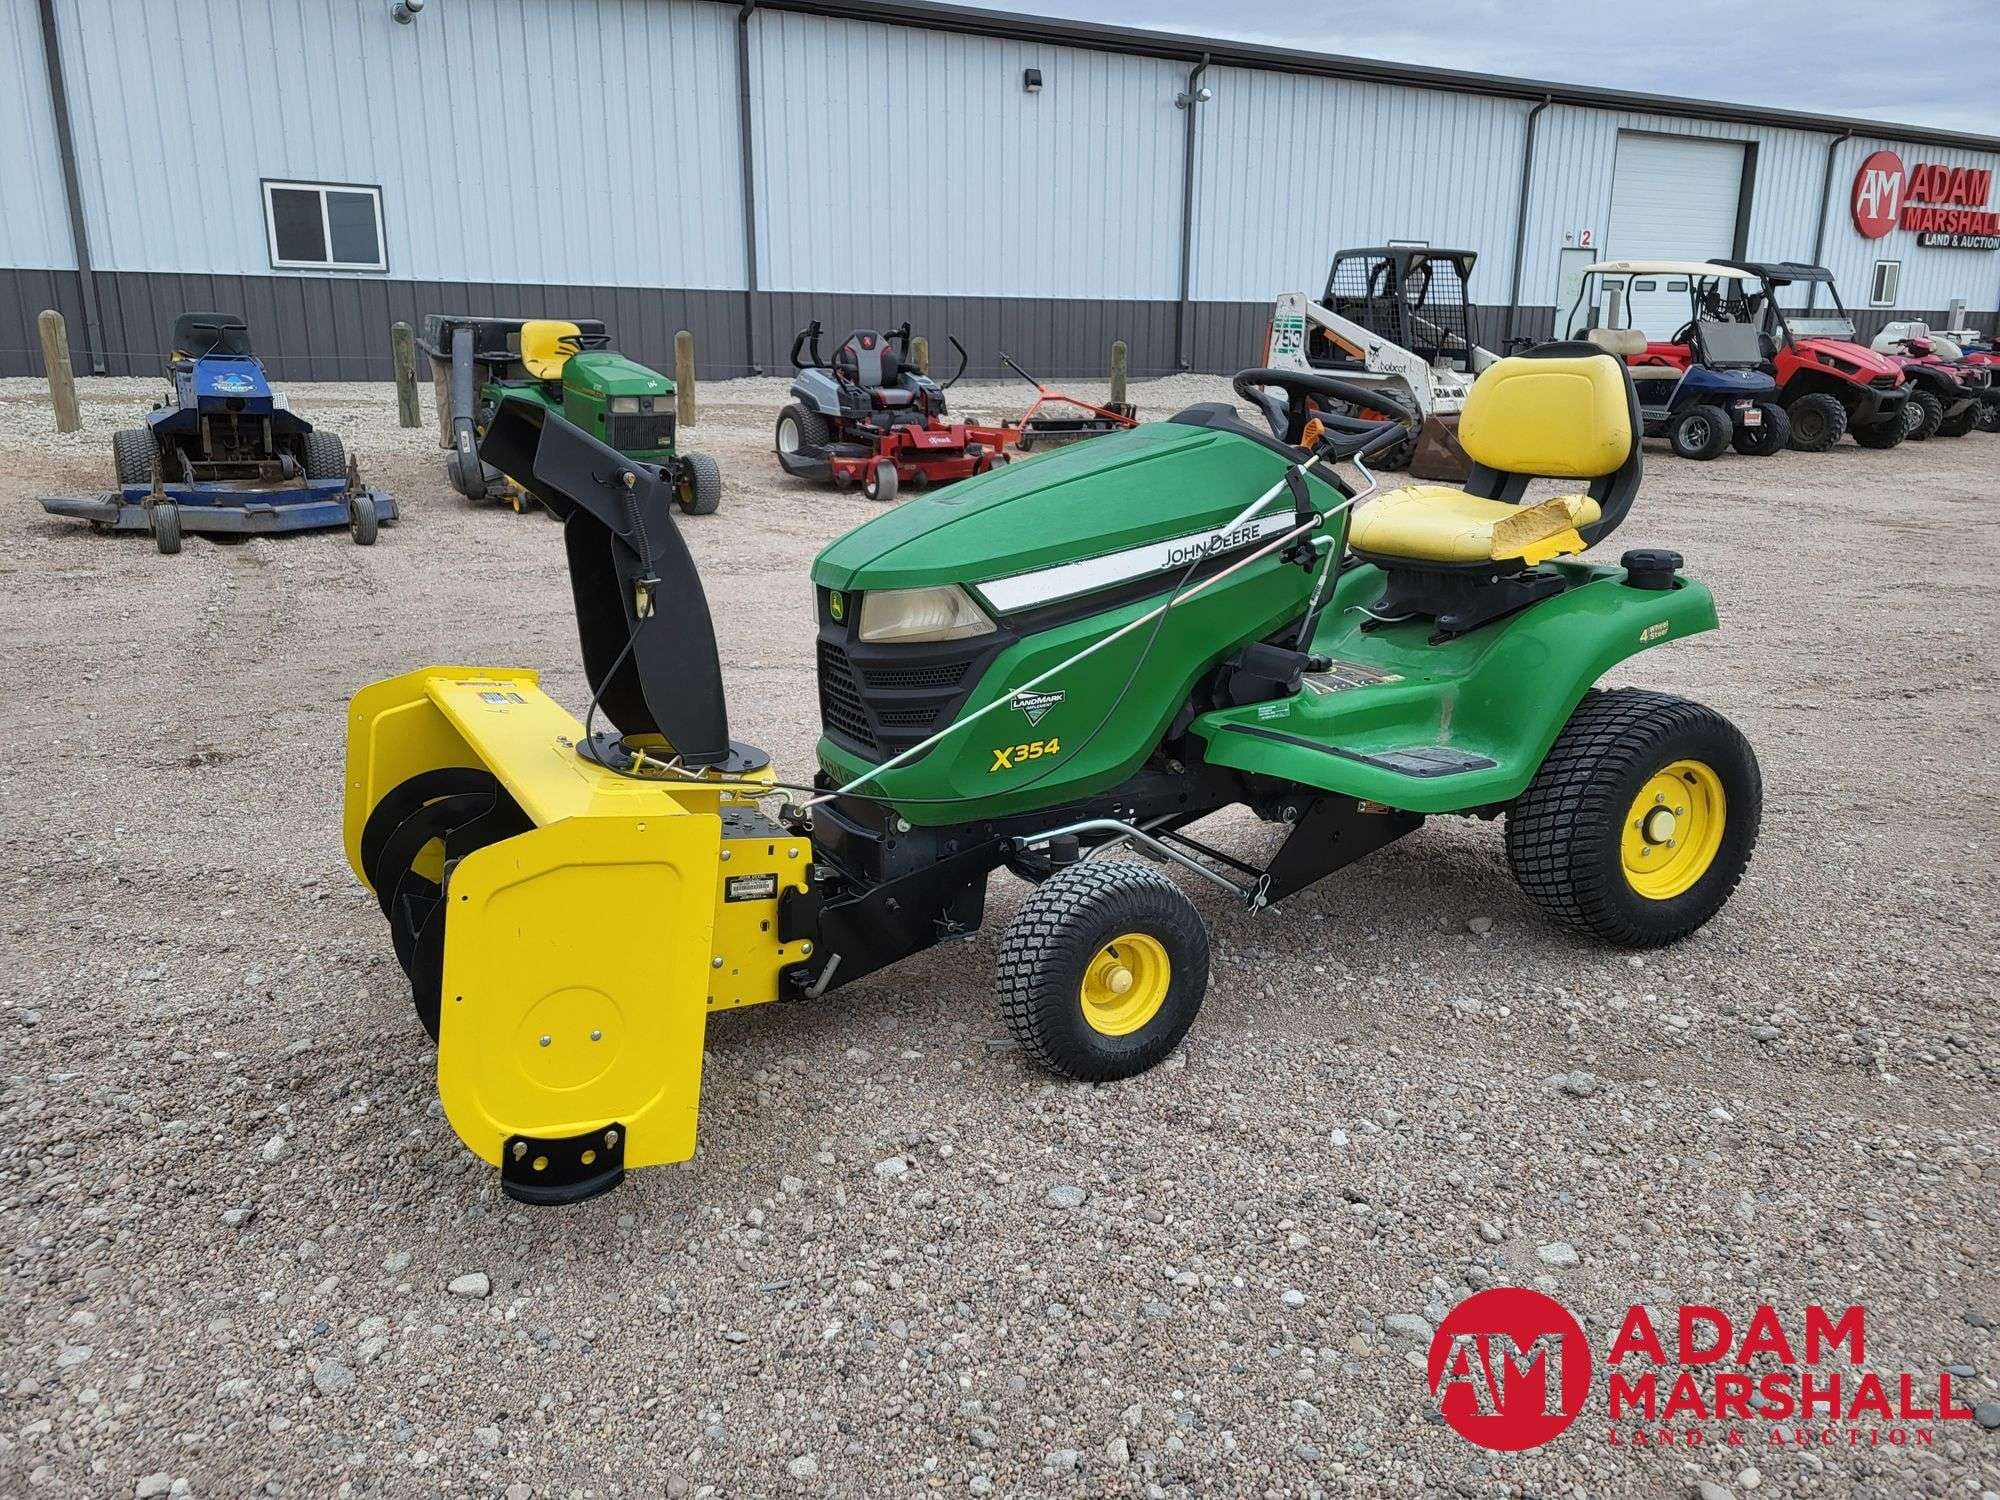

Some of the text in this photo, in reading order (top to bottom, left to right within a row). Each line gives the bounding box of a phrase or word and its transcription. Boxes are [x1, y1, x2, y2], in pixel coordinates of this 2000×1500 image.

[1908, 163, 1992, 206] ADAM
[1581, 229, 1592, 246] 2
[1924, 233, 2000, 249] LAND & AUCTION
[1274, 328, 1303, 349] 753
[1161, 524, 1261, 567] JOHN DEERE
[1639, 629, 1648, 641] 4
[989, 737, 1060, 772] X354
